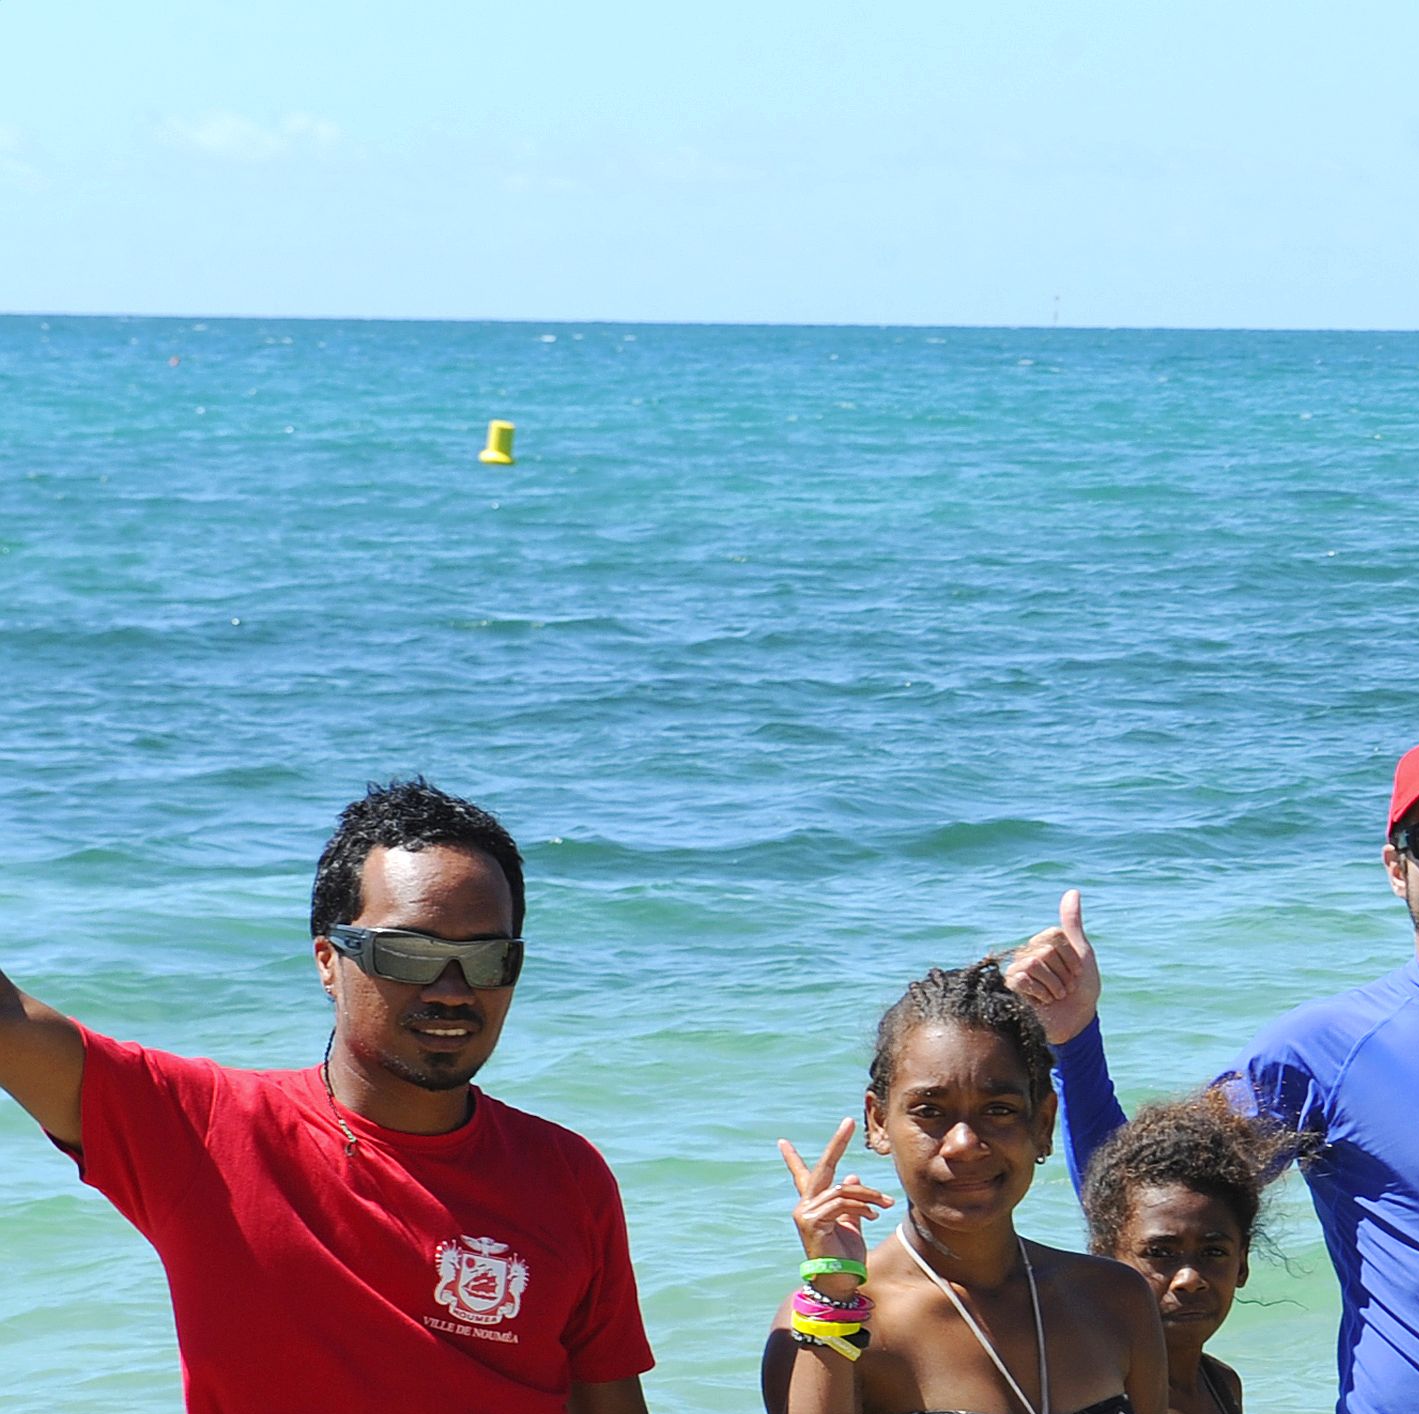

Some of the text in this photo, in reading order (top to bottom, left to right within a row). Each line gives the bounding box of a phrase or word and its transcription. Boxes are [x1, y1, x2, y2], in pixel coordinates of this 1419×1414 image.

[423, 1315, 519, 1344] VILLE DE NOUMÉA
